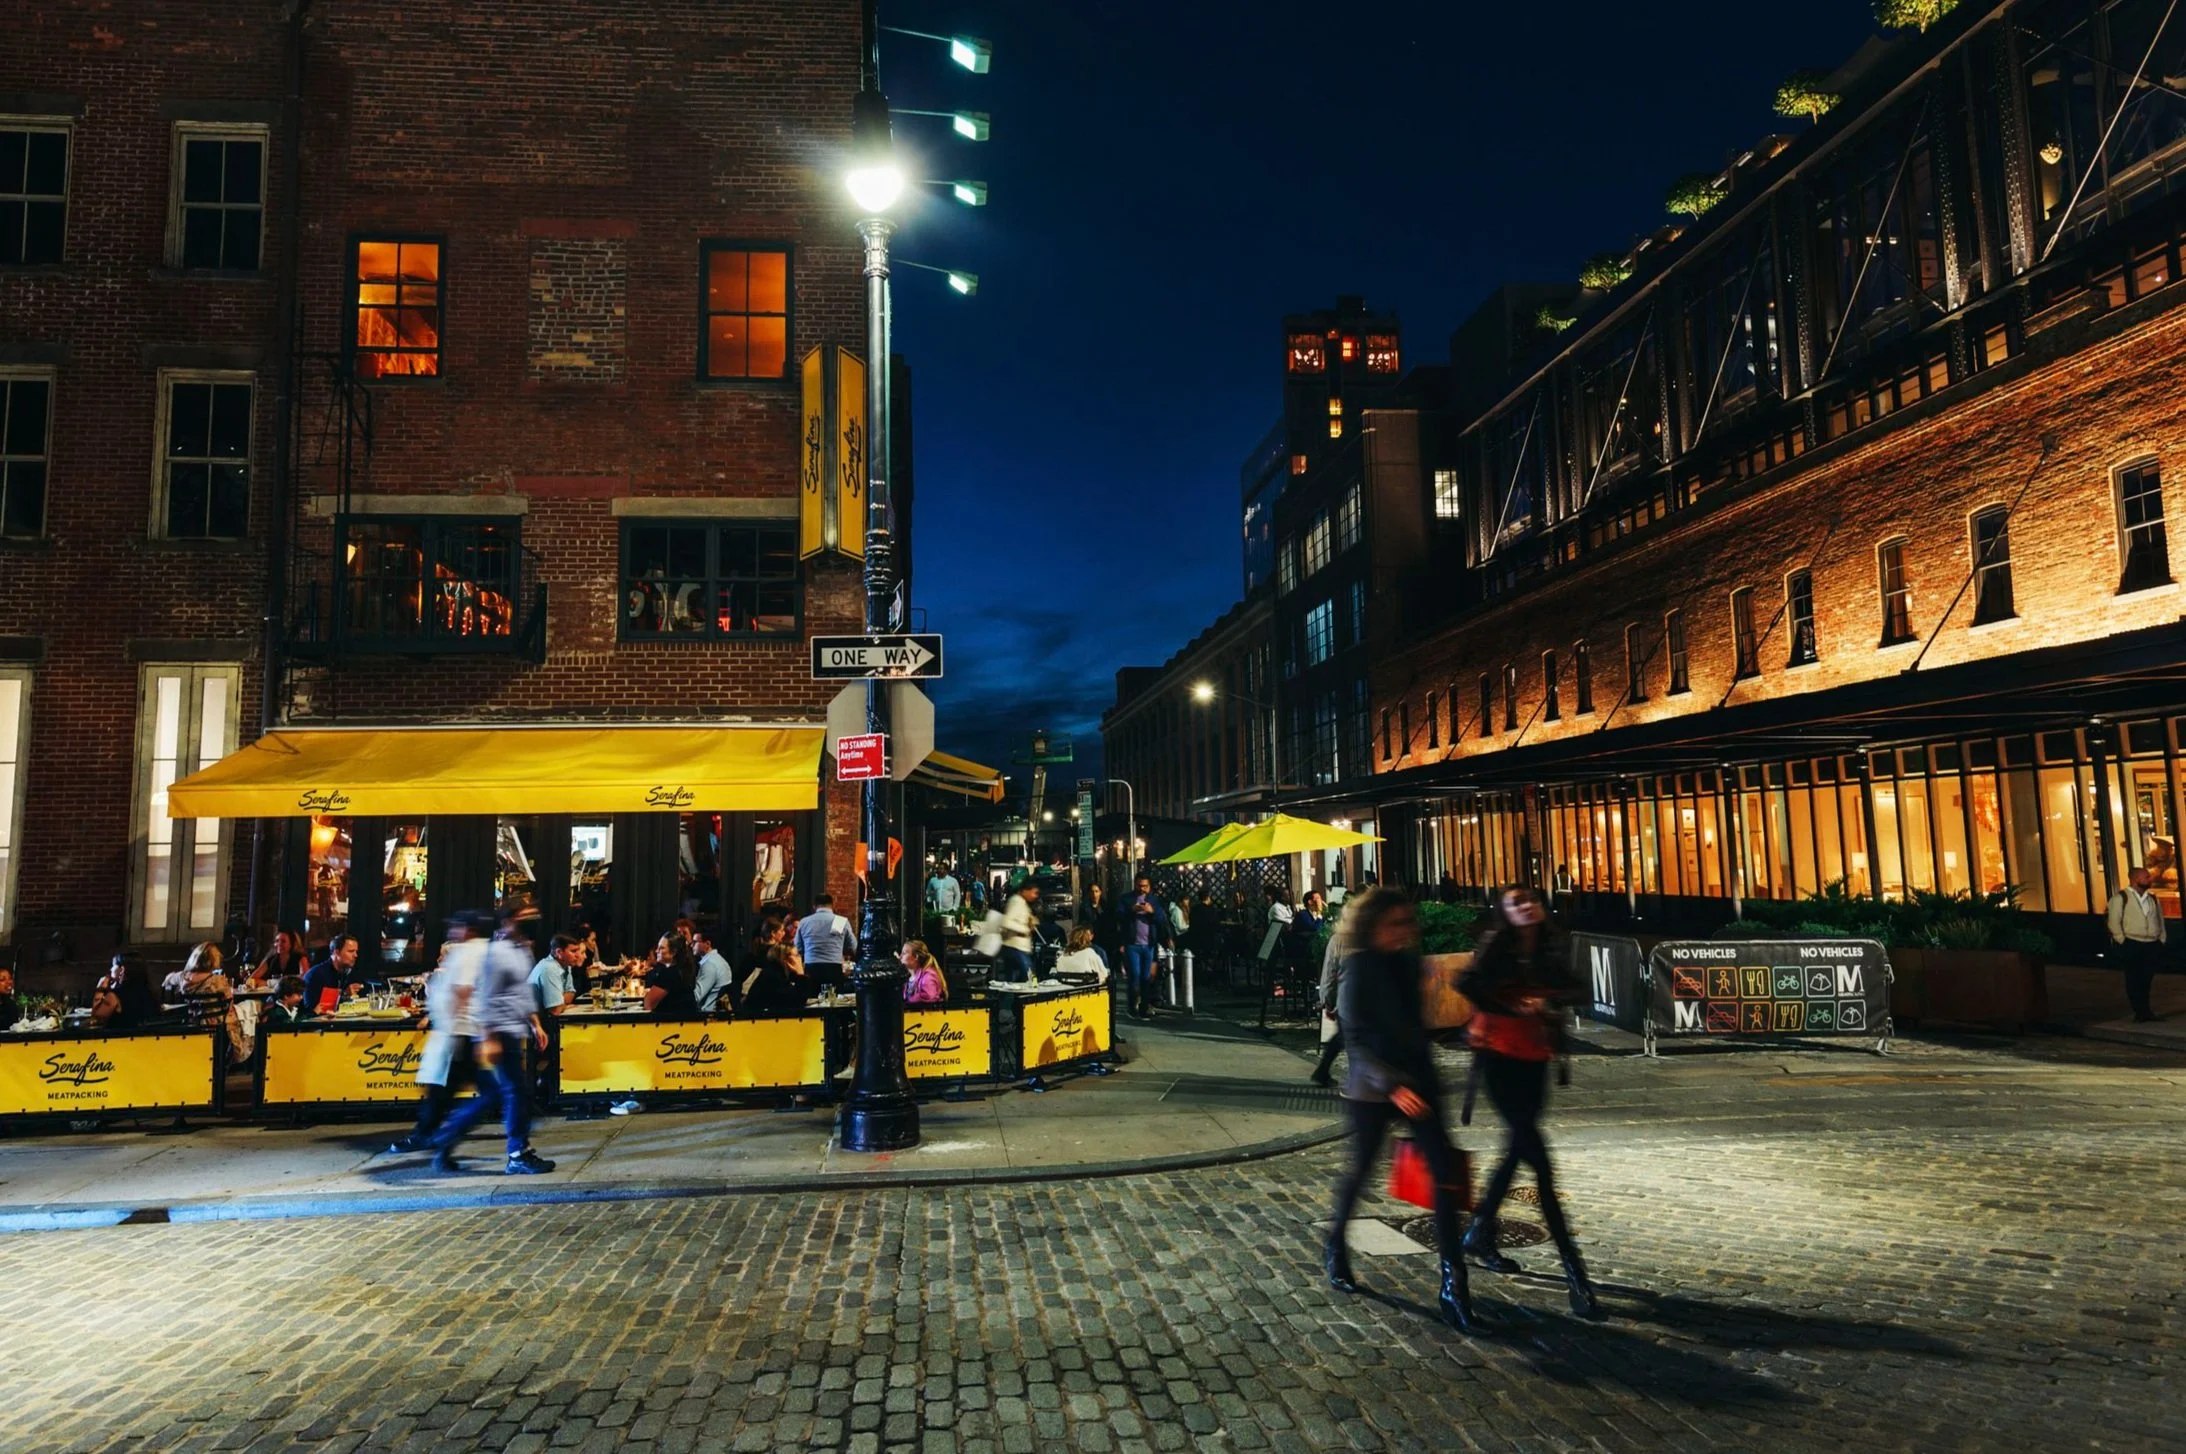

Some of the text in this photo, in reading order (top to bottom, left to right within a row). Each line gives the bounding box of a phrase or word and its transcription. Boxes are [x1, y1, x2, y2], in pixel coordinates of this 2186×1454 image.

[831, 649, 922, 665] ONE WAY
[840, 739, 877, 750] NO STANDING
[840, 751, 864, 760] Anytime
[298, 789, 350, 812] Serafina
[645, 785, 695, 808] Serafina
[1672, 948, 1737, 959] NO VEHICLES
[1800, 946, 1864, 958] NO VEHICLES
[904, 1022, 964, 1054] Serafina
[656, 1033, 727, 1066] Serafina
[358, 1043, 424, 1076] Serafin
[908, 1058, 960, 1067] MEATPACKING
[39, 1052, 115, 1086] Serafina
[665, 1070, 722, 1079] MEATPACKING
[48, 1090, 108, 1100] MEATPACKING
